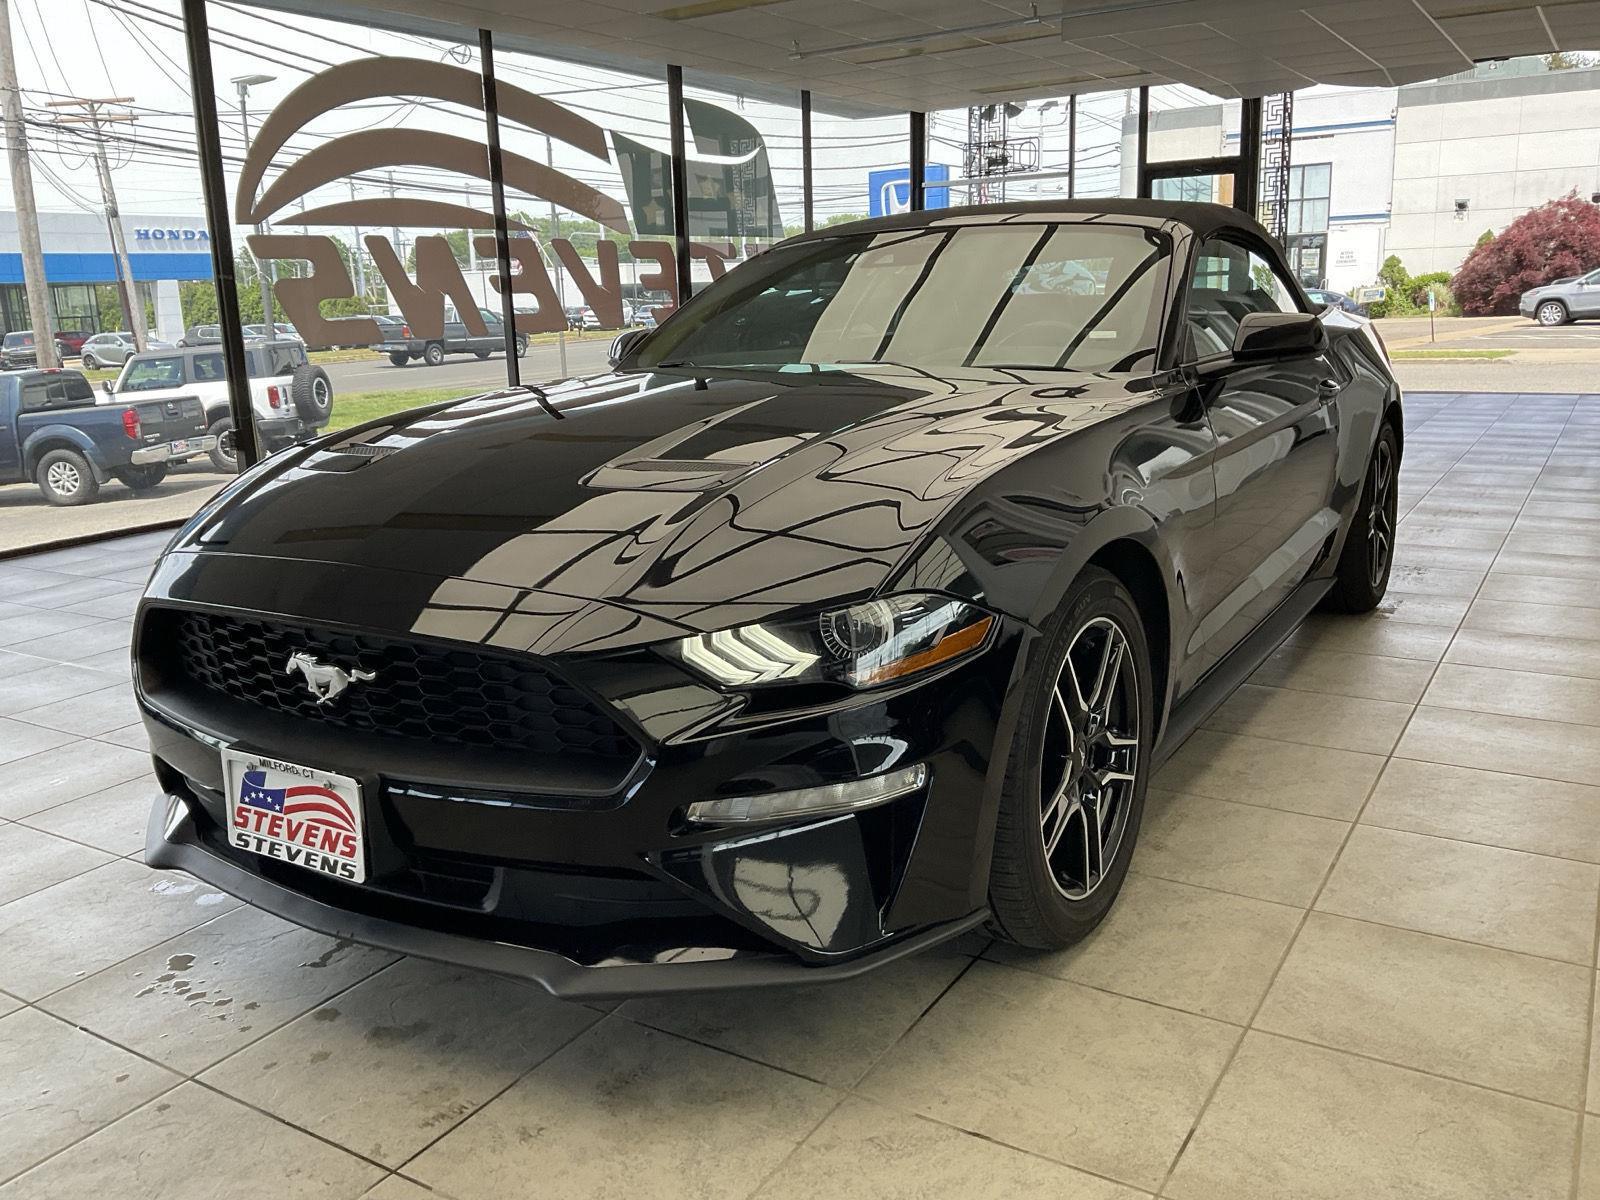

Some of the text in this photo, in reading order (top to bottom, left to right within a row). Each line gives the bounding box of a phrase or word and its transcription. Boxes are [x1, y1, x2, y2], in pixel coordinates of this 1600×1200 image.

[135, 229, 209, 241] HONDA
[302, 766, 315, 779] CT
[234, 805, 357, 859] STEVENS
[235, 832, 357, 880] STEVENS
